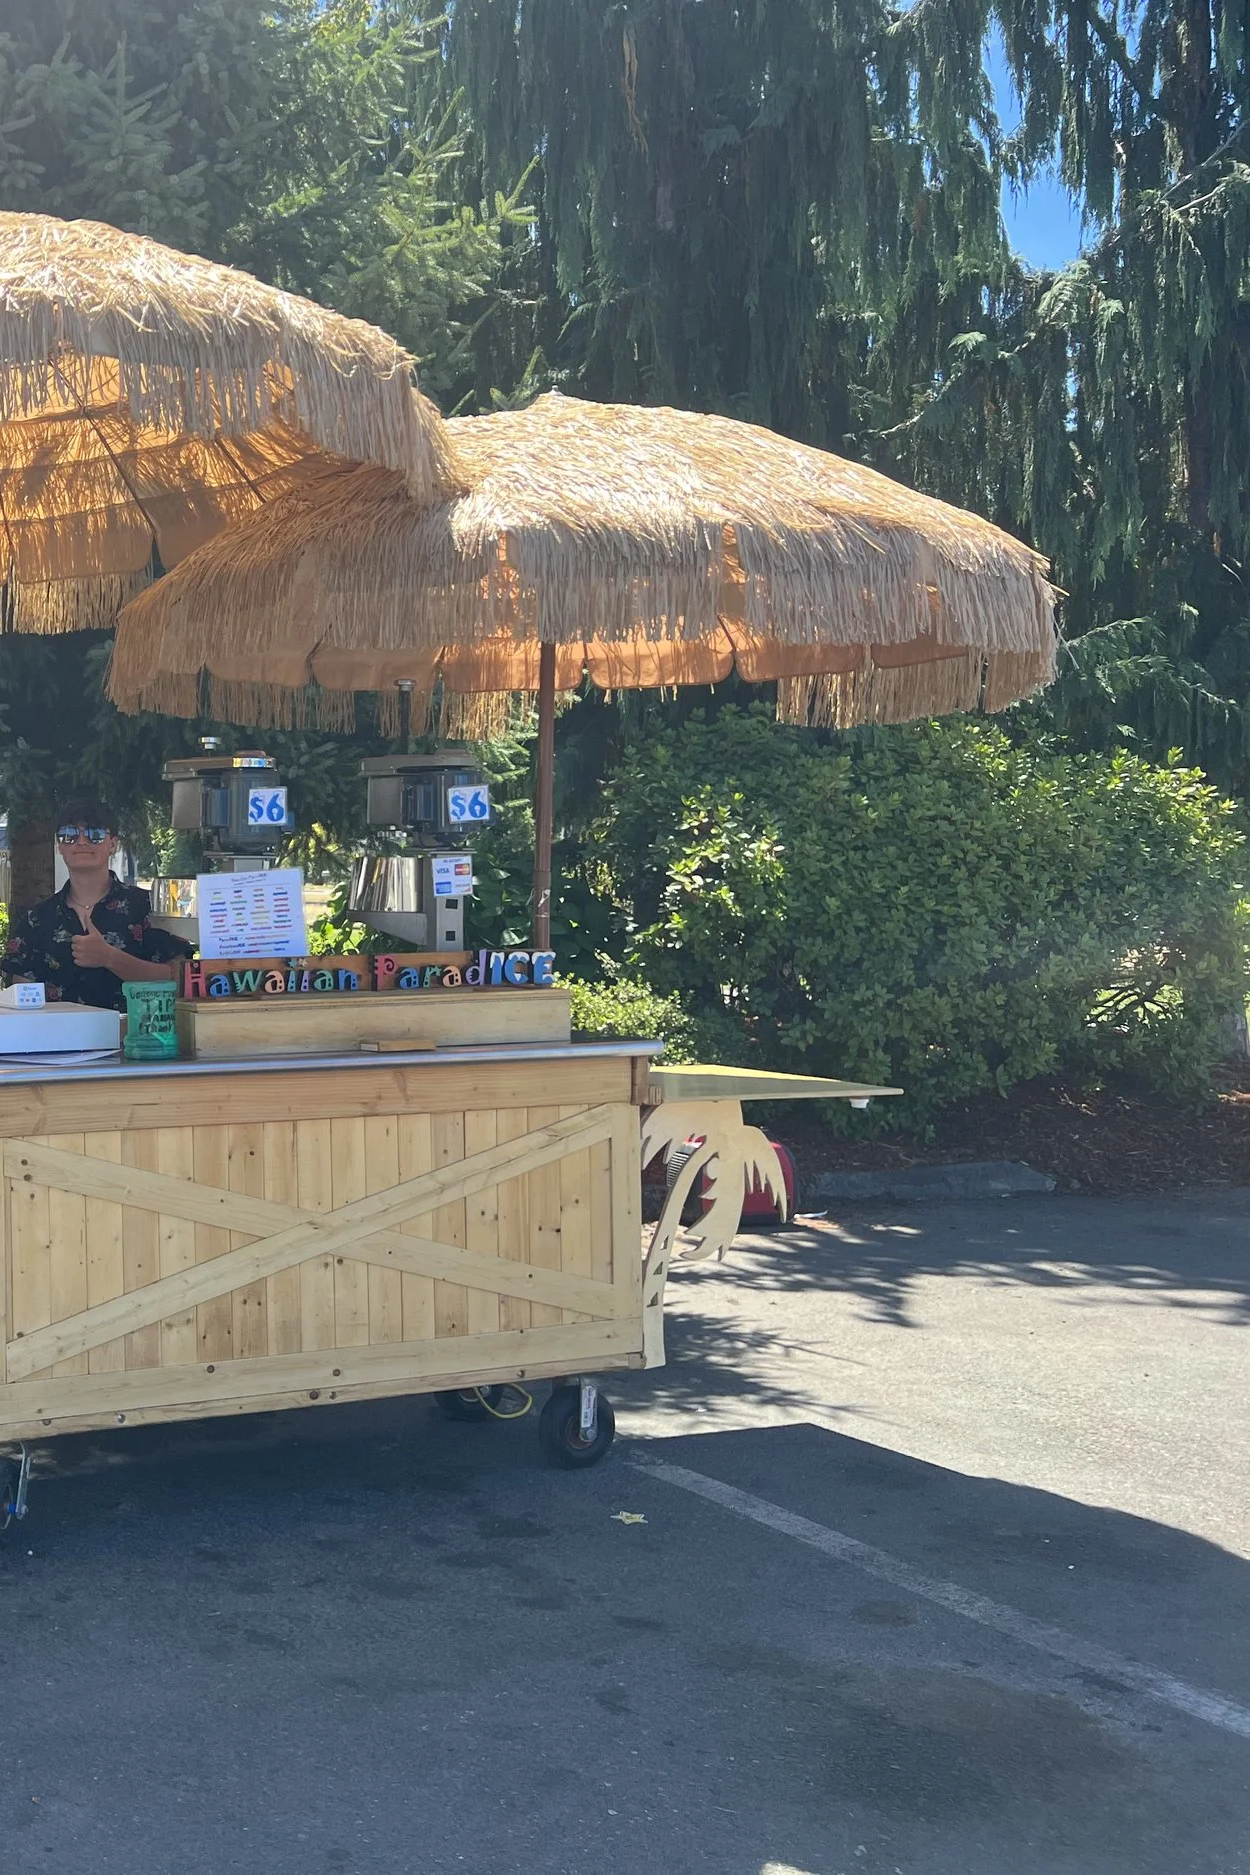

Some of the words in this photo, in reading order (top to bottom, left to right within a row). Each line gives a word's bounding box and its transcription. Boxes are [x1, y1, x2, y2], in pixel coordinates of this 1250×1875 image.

[249, 793, 284, 822] $6
[451, 791, 486, 819] $6
[184, 958, 359, 998] Hawaiian
[374, 949, 556, 991] ParadICE
